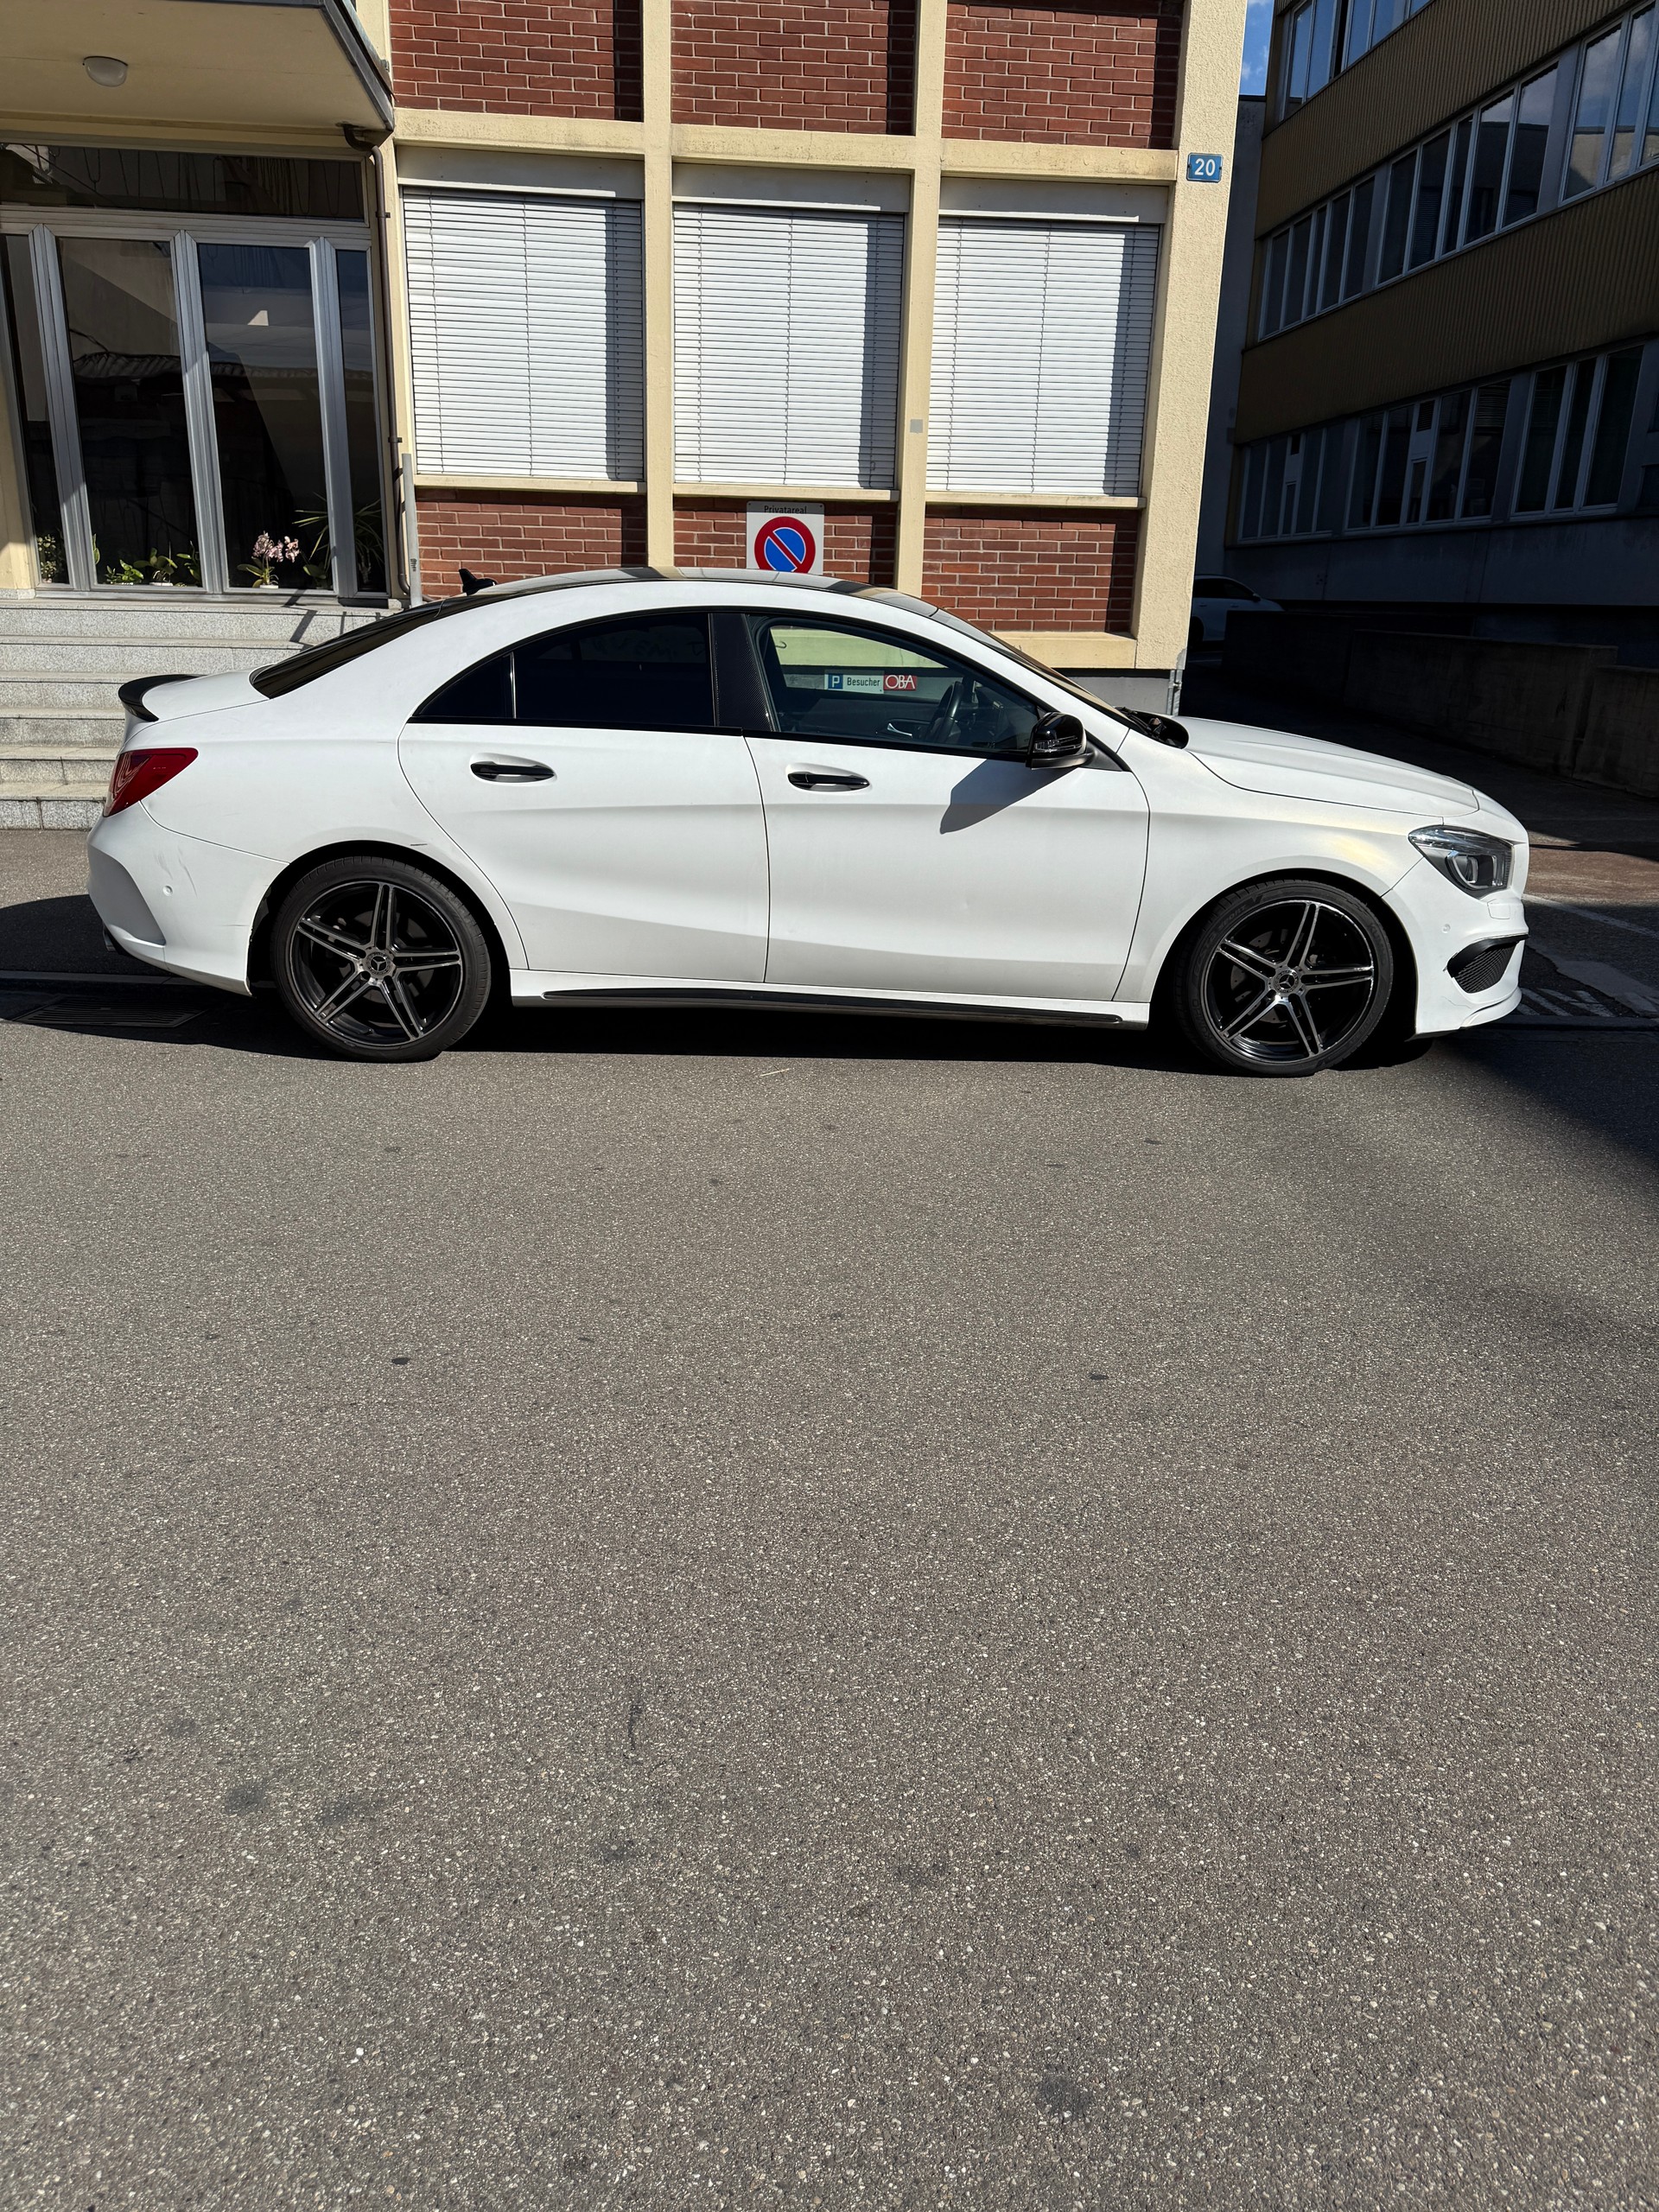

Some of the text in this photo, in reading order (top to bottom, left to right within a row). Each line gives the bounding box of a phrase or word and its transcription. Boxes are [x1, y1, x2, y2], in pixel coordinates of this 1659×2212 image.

[1194, 158, 1216, 176] 20
[764, 505, 807, 514] Privatareal
[832, 676, 880, 688] P Besucher
[885, 675, 916, 689] OBA
